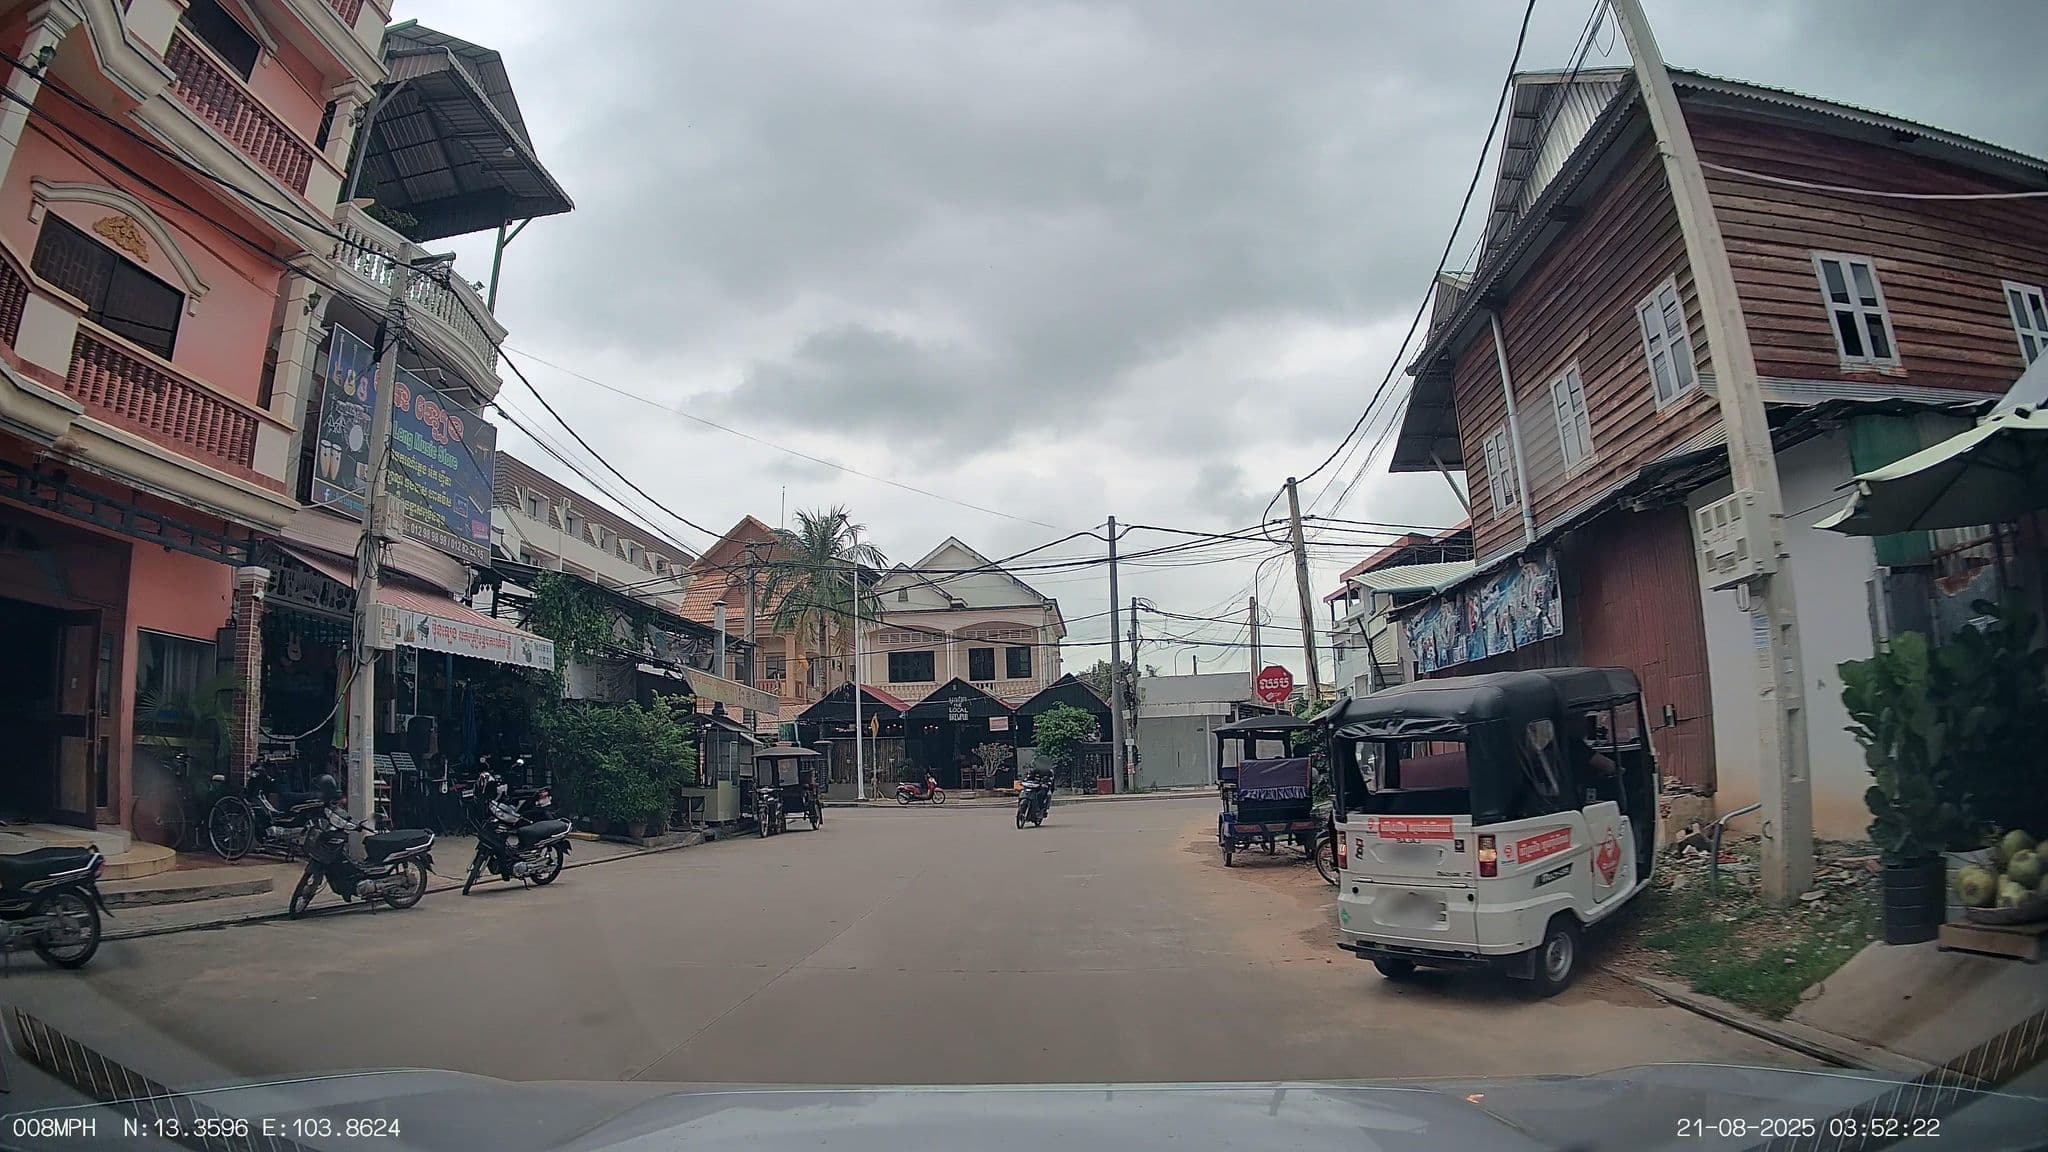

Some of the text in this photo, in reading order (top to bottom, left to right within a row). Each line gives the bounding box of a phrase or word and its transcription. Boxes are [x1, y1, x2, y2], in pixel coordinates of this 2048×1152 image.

[414, 432, 437, 460] Music
[437, 445, 458, 471] Store
[410, 523, 422, 537] 012
